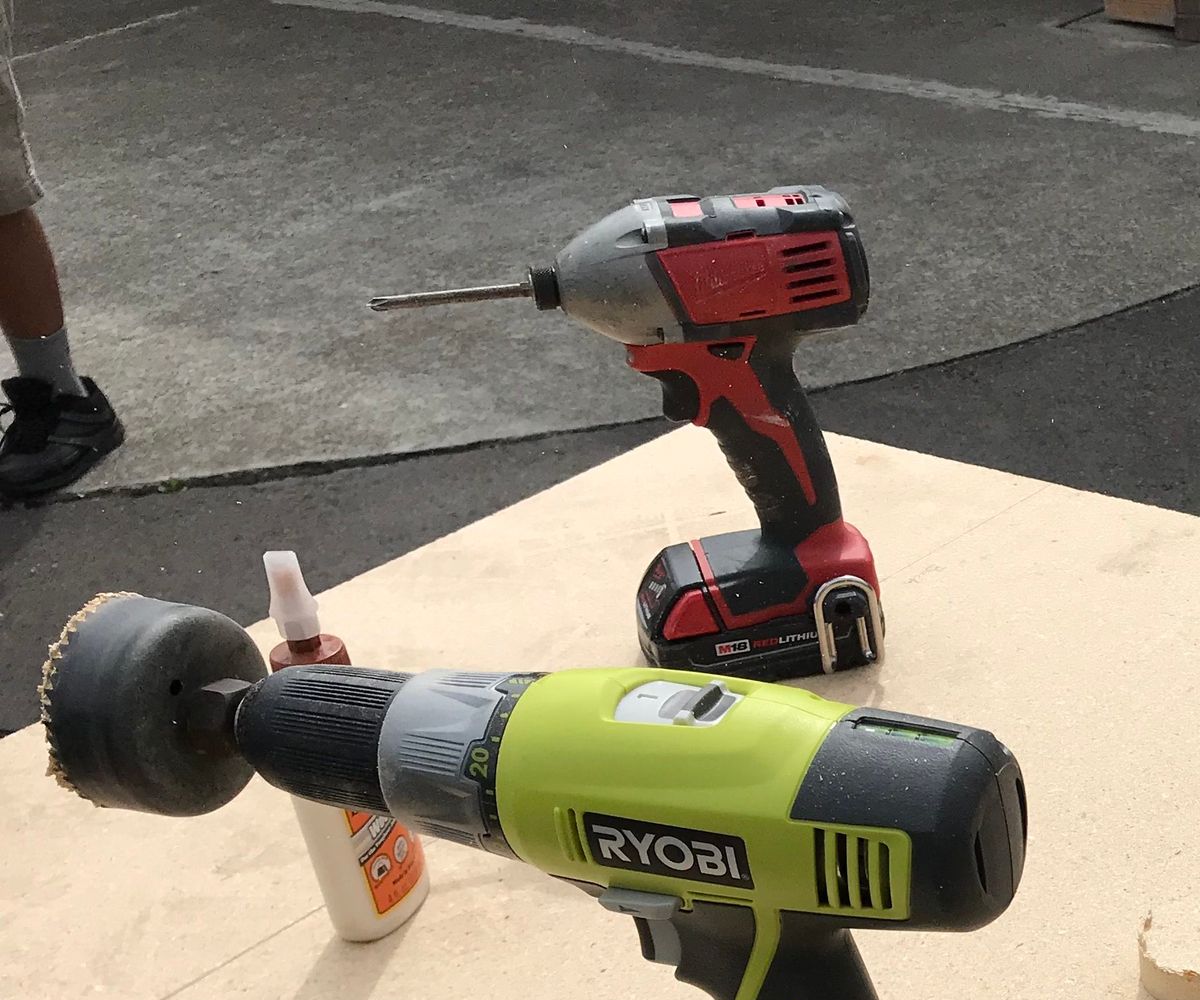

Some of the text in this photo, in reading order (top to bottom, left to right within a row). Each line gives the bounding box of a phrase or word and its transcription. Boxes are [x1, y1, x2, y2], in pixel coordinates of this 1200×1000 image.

[718, 631, 819, 655] M18 REDLITHIU
[469, 747, 490, 779] 20
[592, 824, 741, 880] RYOBI
